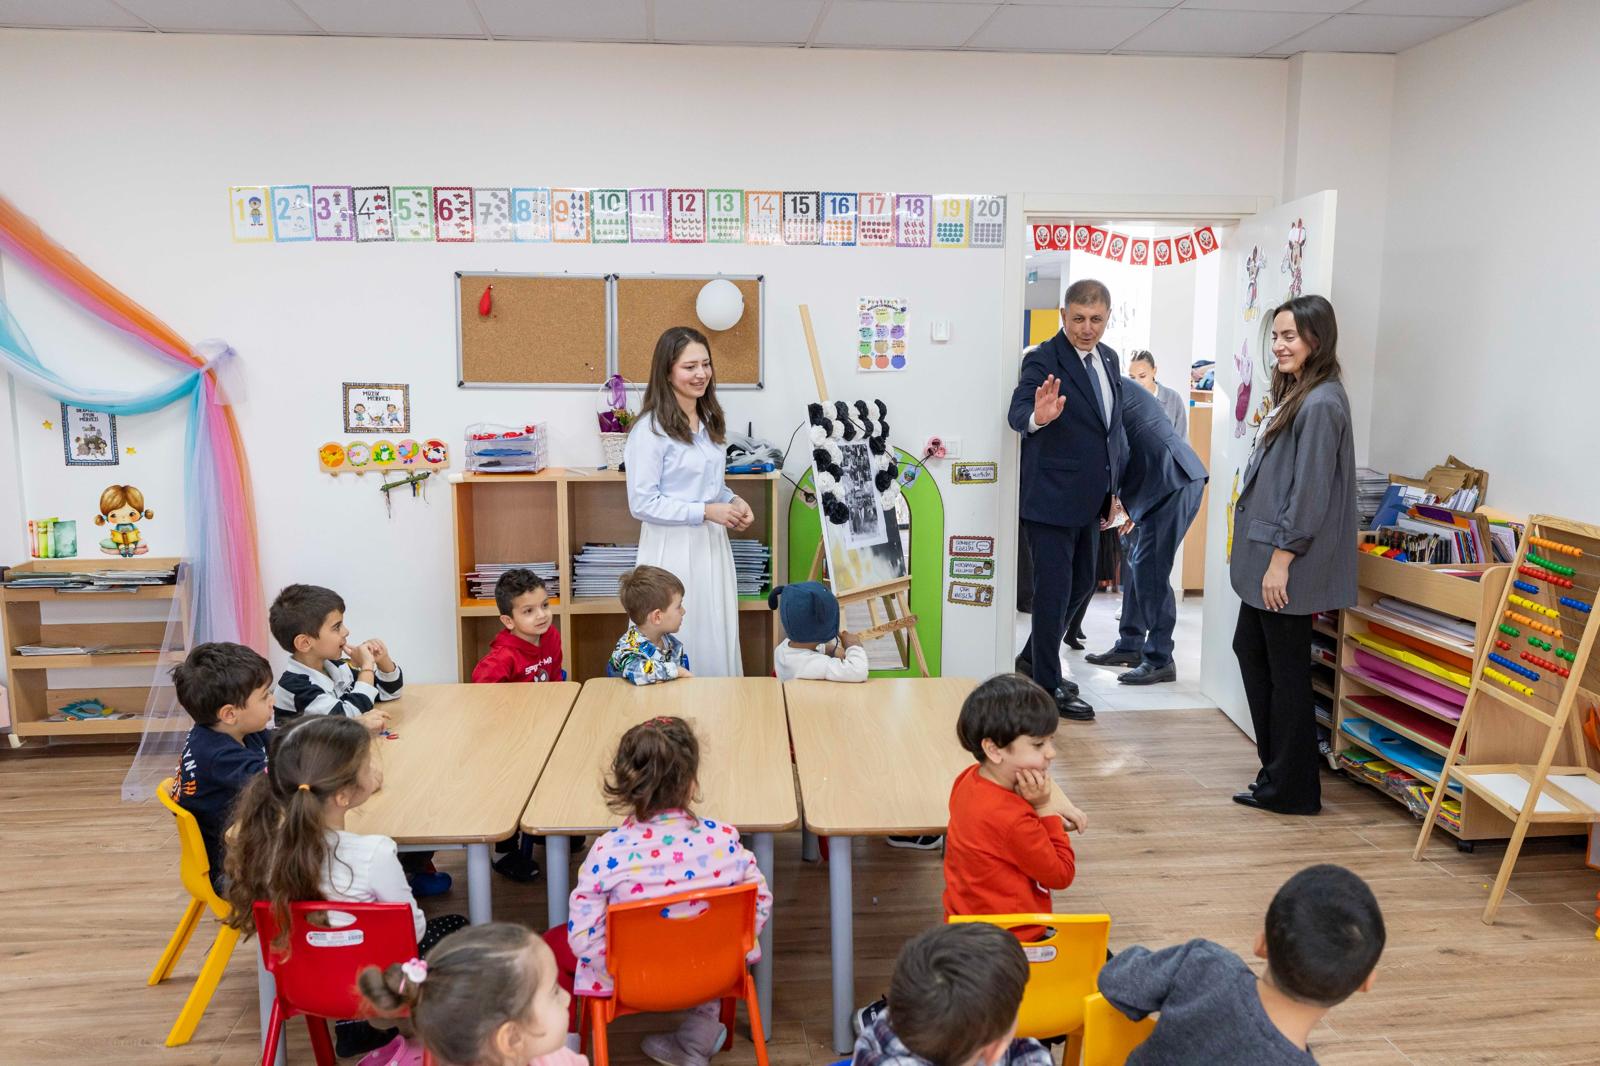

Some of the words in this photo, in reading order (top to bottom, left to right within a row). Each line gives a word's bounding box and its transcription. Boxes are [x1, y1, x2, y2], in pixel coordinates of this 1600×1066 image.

[236, 199, 245, 220] 1
[277, 198, 291, 220] 2
[317, 197, 332, 220] 3
[358, 197, 375, 219] 4
[399, 199, 411, 220] 5
[439, 198, 454, 220] 6
[517, 199, 532, 222] 8
[555, 200, 569, 222] 9
[599, 194, 620, 212] 10
[640, 193, 654, 211] 11
[677, 194, 696, 212] 12
[715, 194, 734, 212] 13
[754, 197, 775, 215] 14
[791, 196, 810, 214] 15
[831, 197, 850, 215] 16
[868, 197, 886, 215] 17
[905, 198, 924, 217] 18
[942, 198, 960, 217] 19
[978, 198, 1001, 217] 20
[479, 202, 493, 225] 7
